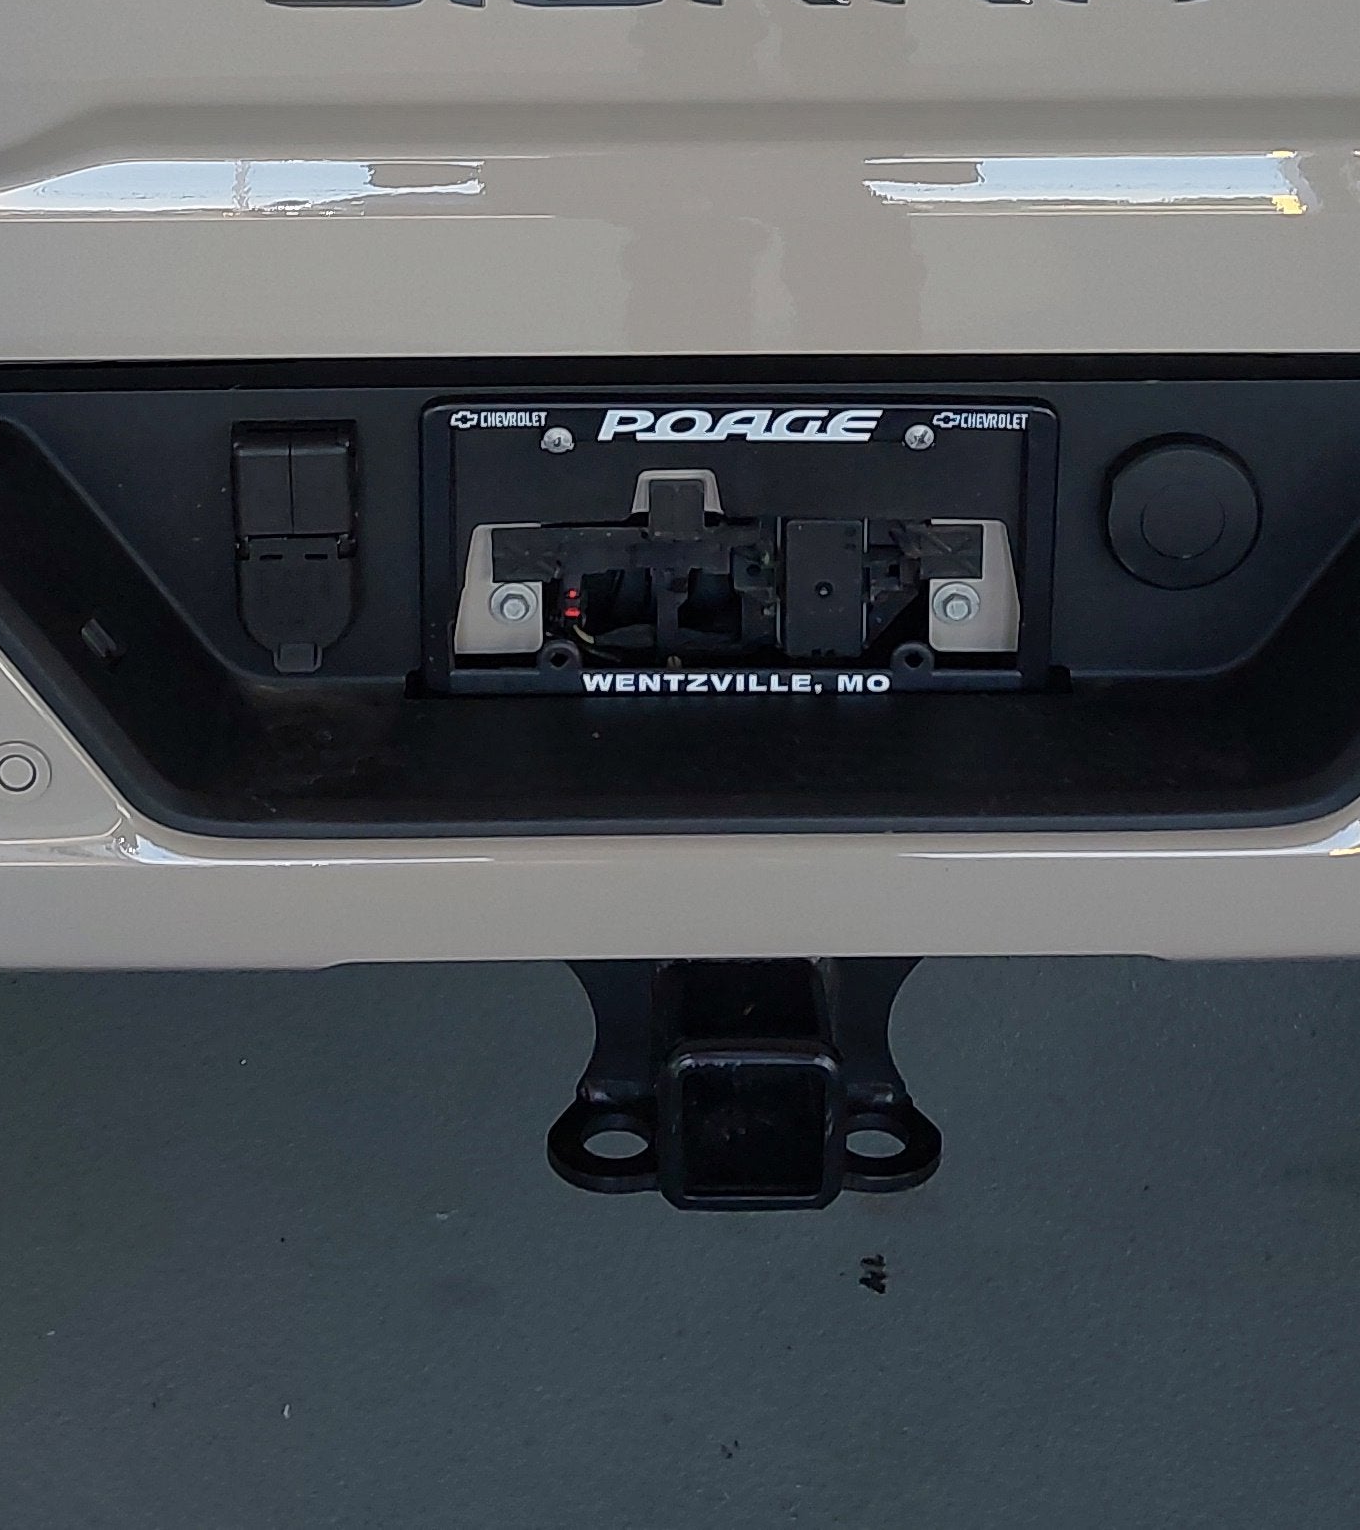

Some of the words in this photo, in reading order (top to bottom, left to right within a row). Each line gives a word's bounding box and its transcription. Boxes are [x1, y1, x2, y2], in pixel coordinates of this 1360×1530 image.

[480, 411, 548, 427] CHEVROLET
[597, 409, 884, 442] POAGE
[960, 413, 1029, 430] CHEVROLET
[582, 672, 822, 694] WENTZVILLE,
[837, 673, 891, 692] MO
